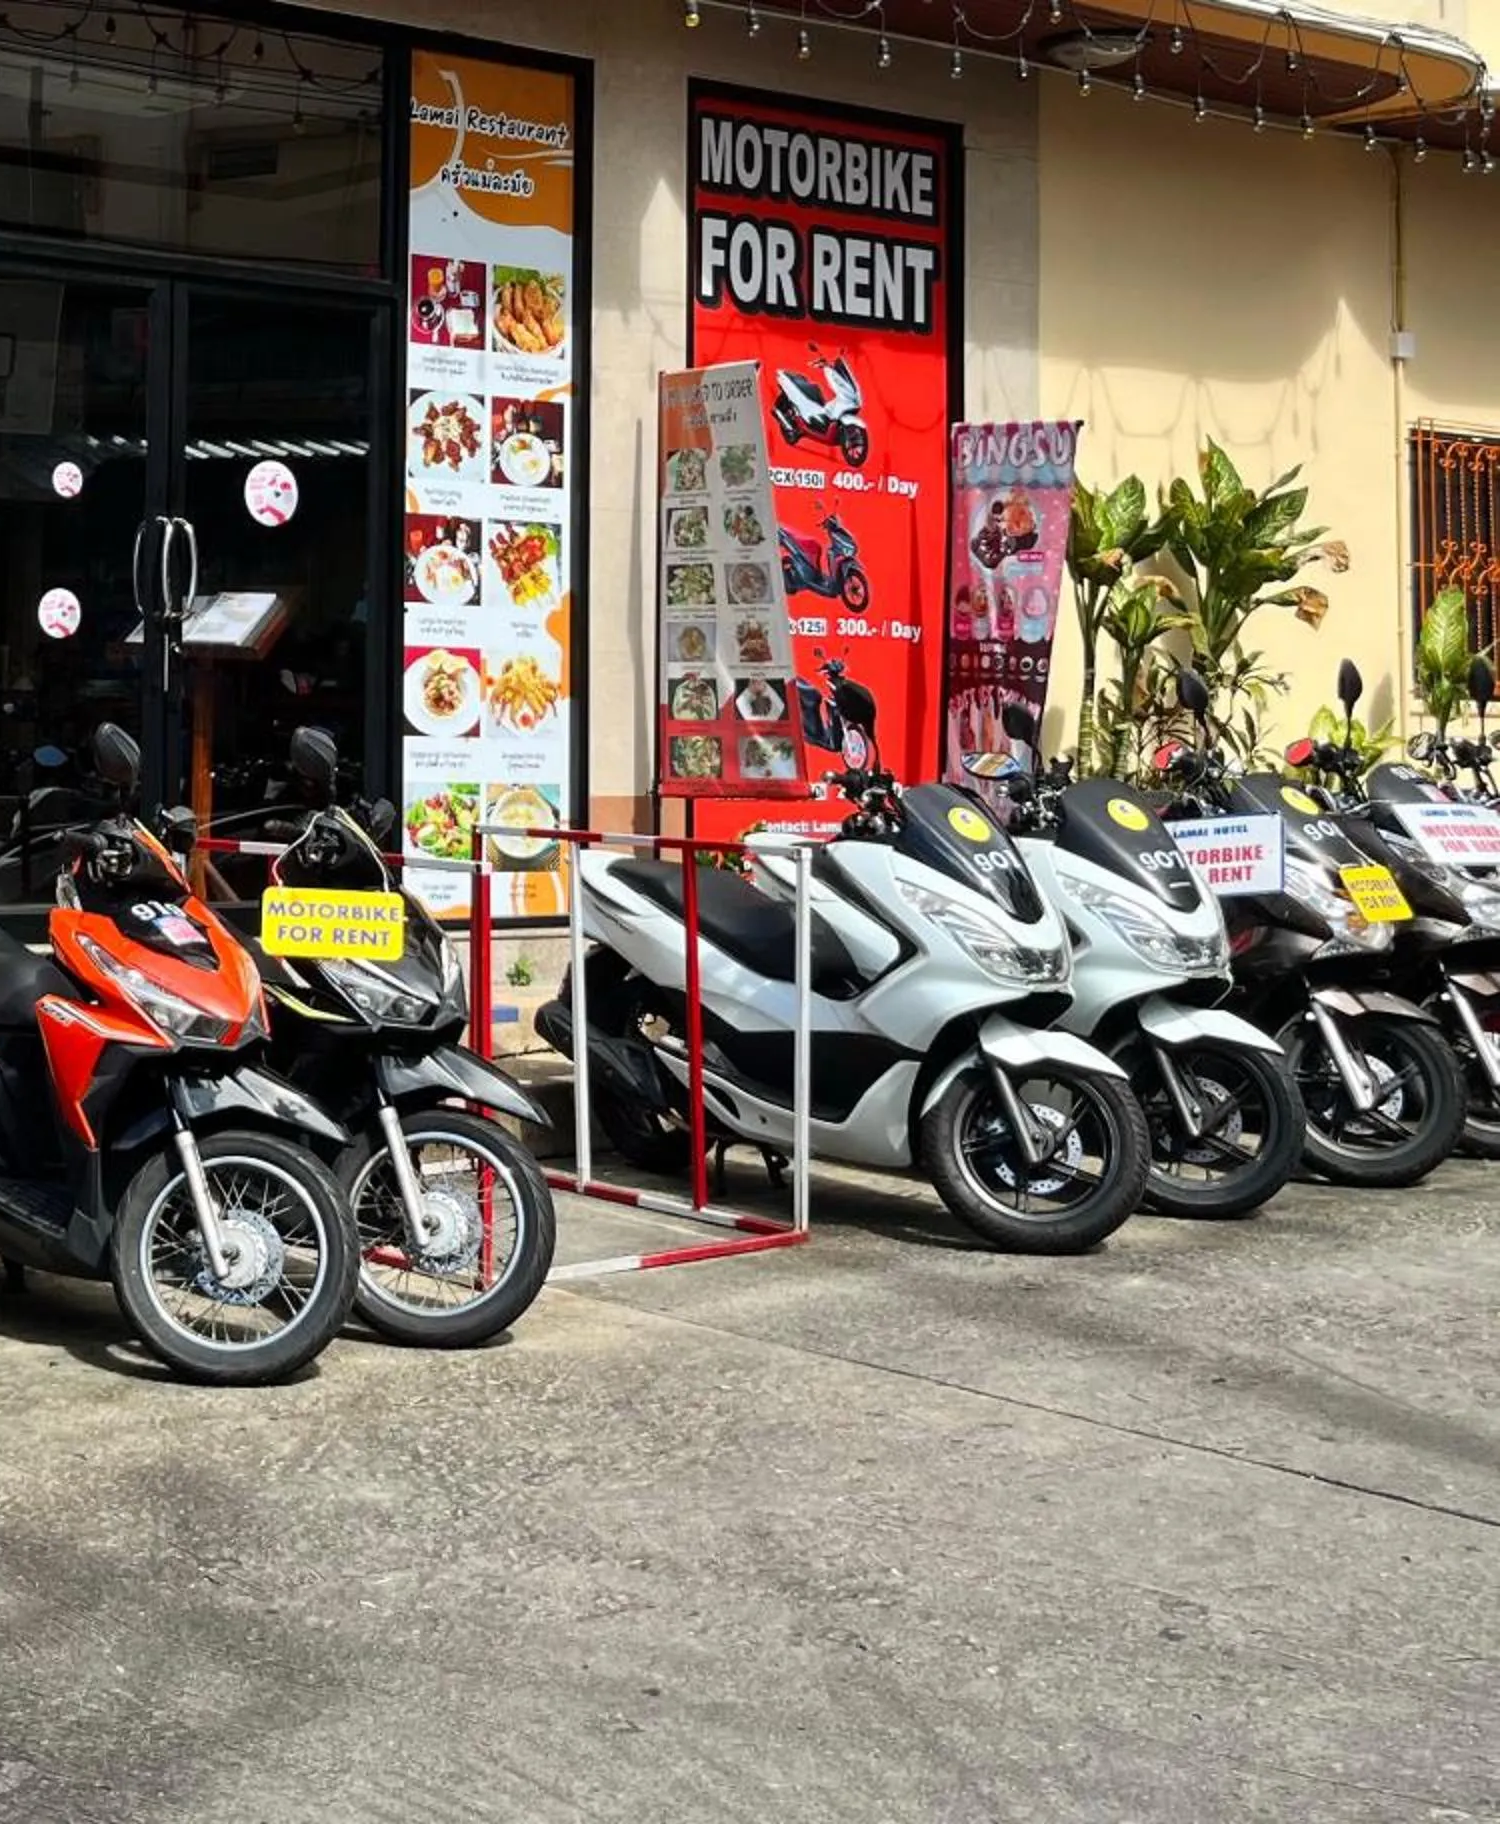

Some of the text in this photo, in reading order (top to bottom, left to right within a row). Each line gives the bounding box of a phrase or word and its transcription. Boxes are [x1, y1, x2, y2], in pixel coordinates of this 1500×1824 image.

[409, 98, 567, 144] Lamai Restaurant
[701, 118, 933, 216] MOTORBIKE
[701, 217, 933, 323] FOR RENT
[957, 429, 1072, 467] BINGSU
[888, 476, 919, 499] Day
[891, 621, 921, 642] Day
[1186, 844, 1264, 865] TORBIKE
[1209, 865, 1254, 884] RENT
[268, 901, 400, 922] MOTORBIKE
[277, 925, 391, 946] FOR RENT
